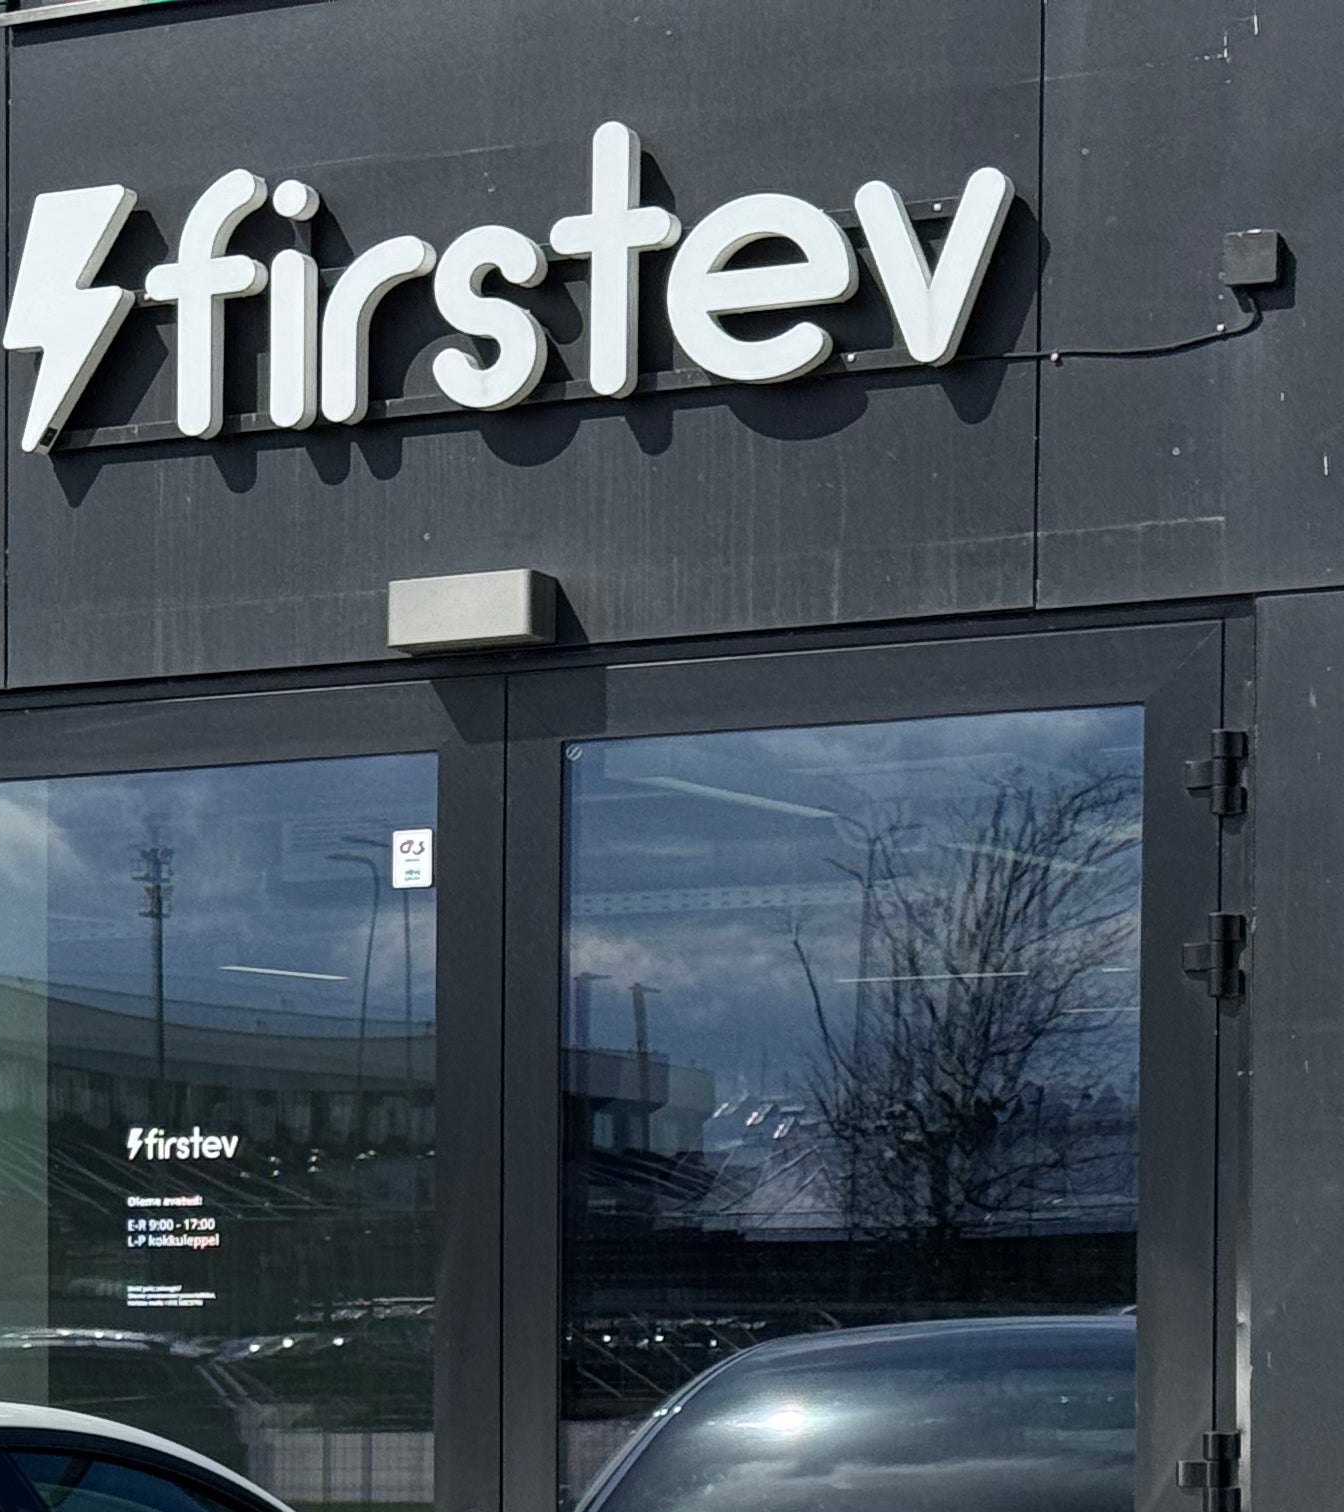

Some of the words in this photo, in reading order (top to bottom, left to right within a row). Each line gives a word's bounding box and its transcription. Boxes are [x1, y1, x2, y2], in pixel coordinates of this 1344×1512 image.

[144, 120, 1015, 440] firstev
[144, 1126, 239, 1160] firstev
[148, 1218, 174, 1232] 9:00
[184, 1217, 216, 1231] 17:00
